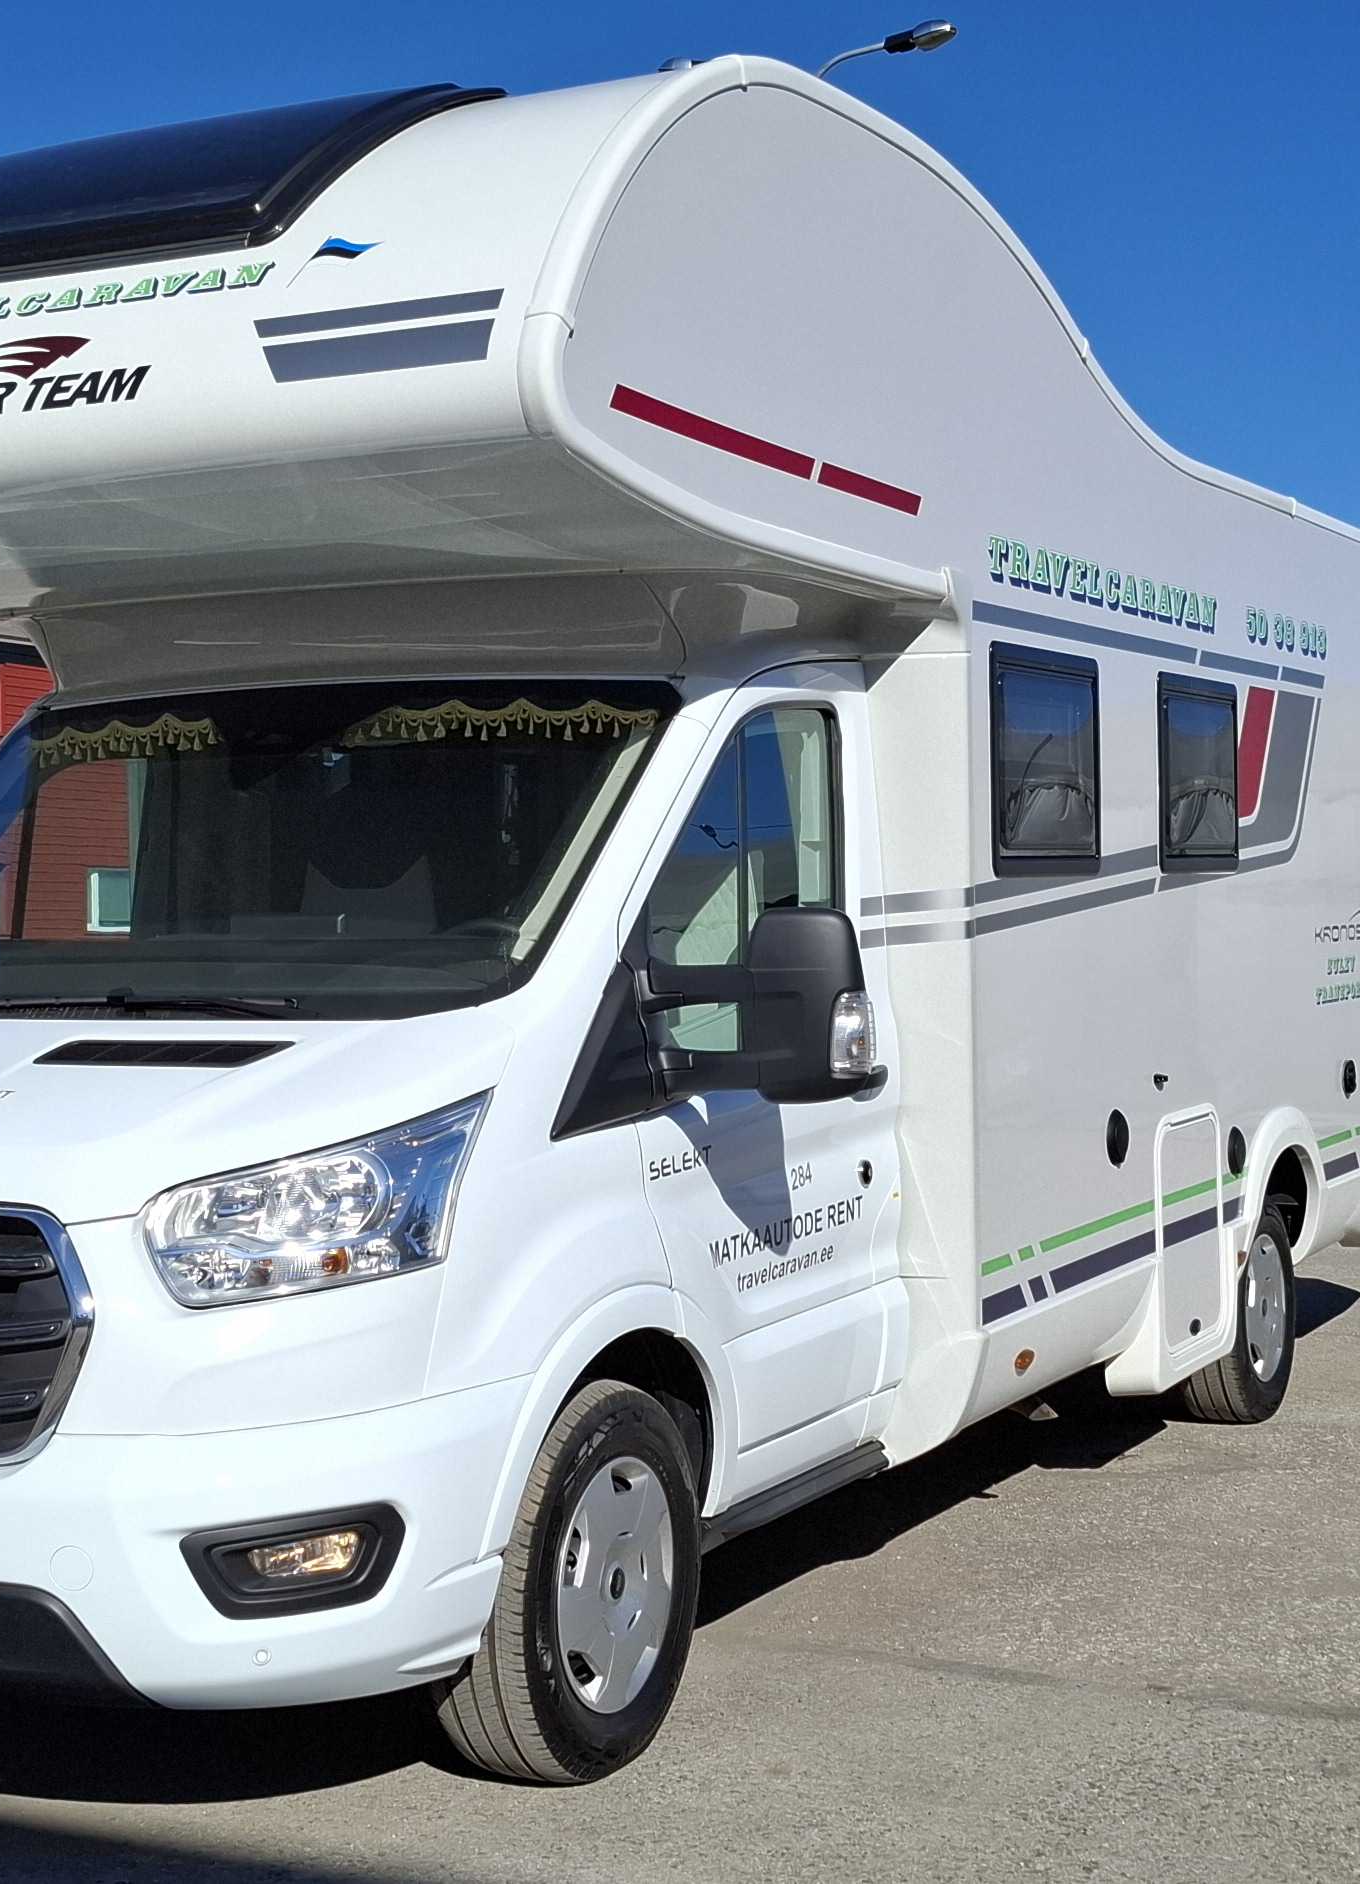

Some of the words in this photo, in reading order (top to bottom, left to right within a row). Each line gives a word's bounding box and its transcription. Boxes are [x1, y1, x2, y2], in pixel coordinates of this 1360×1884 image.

[21, 365, 152, 413] TEAM
[988, 535, 1217, 635] TRAVELCARAVAN
[791, 1162, 813, 1191] 284
[709, 1208, 823, 1269] MATKAAUTODE
[827, 1195, 863, 1230] RENT
[736, 1245, 834, 1293] travelcaravan.ee
